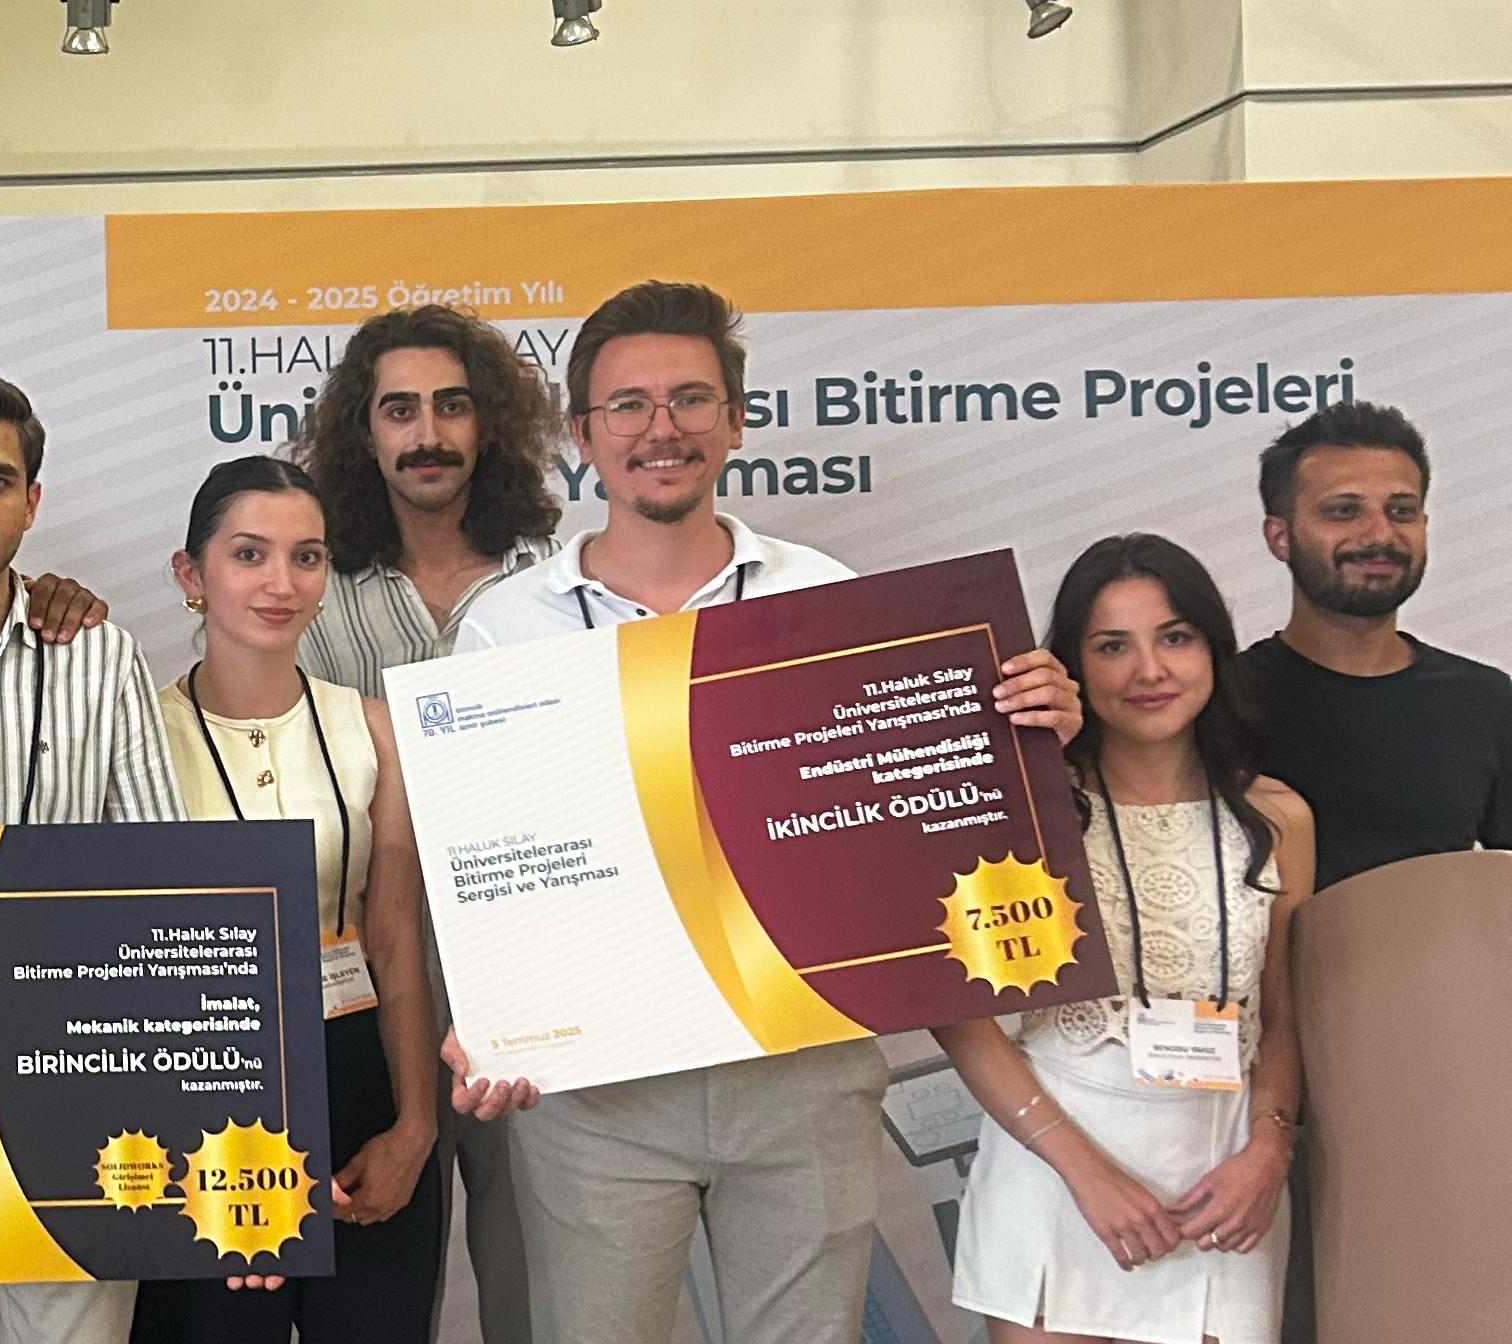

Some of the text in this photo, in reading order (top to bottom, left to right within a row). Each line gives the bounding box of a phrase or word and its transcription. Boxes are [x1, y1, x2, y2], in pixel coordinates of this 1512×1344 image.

[204, 288, 279, 313] 2024
[307, 285, 378, 310] 2025
[388, 280, 511, 307] Öğretim
[521, 279, 563, 305] Yılı
[814, 369, 1060, 426] Bitirme
[1084, 357, 1354, 429] Projeleri
[863, 666, 973, 697] 11.Haluk Sılay
[832, 684, 978, 721] Üniversitelerarası
[729, 700, 982, 758] Bitirme Projeleri Yarışması'nda
[799, 732, 990, 780] Endüstri Mühendisliği
[872, 753, 995, 785] kategorisinde
[766, 800, 885, 841] İKİNCİLİK
[922, 809, 1008, 834] kazanmıştır.
[450, 838, 593, 872] Üniversitelerarası
[454, 852, 587, 888] Bitirme Projeleri
[457, 866, 620, 903] Sergisi ve Yarışması
[966, 896, 1053, 931] 7.500
[151, 926, 257, 944] 11.Haluk Sılay
[996, 935, 1042, 961] TL
[118, 943, 257, 961] Üniversitelerarası
[13, 961, 258, 981] Bitirme Projeleri Yarışması'nda
[200, 993, 261, 1013] İmalat,
[66, 1016, 261, 1035] Mekanik kategorisinde
[17, 1047, 147, 1075] BİRİNCİLİK
[181, 1078, 264, 1094] kazanmıştır.
[196, 1167, 299, 1192] 12.500
[228, 1204, 269, 1227] TL
